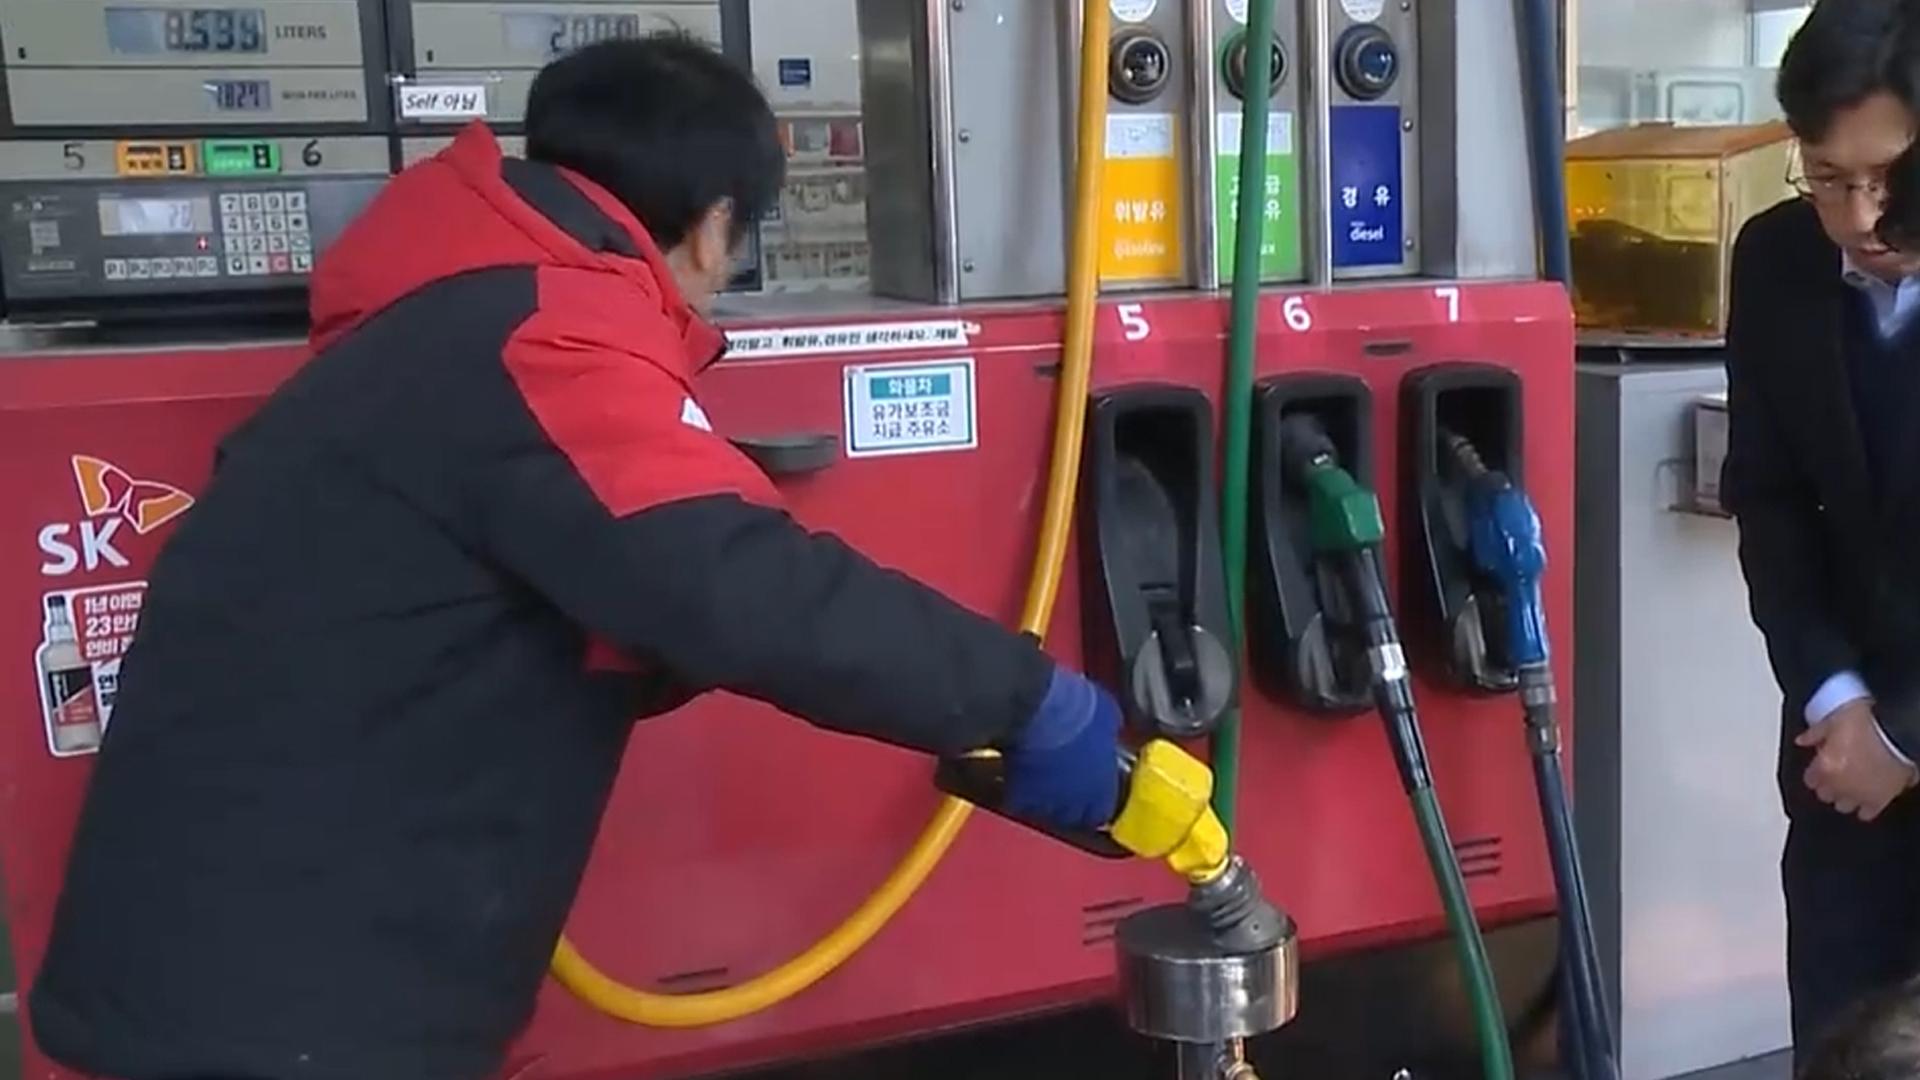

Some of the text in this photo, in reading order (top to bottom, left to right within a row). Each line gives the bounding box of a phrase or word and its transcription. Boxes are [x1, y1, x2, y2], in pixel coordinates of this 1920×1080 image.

[275, 25, 328, 40] LITERS
[405, 93, 478, 111] Self 아님
[63, 143, 86, 172] 5
[301, 139, 323, 168] 6
[225, 196, 237, 211] 7
[268, 195, 280, 209] 9
[1114, 199, 1168, 223] 휘발유
[270, 217, 283, 230] 6
[1350, 224, 1384, 242] diesel
[273, 237, 285, 250] 3
[1282, 295, 1312, 331] 6
[1434, 287, 1459, 322] 7
[1117, 302, 1150, 341] 5
[872, 401, 950, 420] 유가보조금
[873, 419, 951, 438] 지급 주유소
[37, 517, 130, 576] SK
